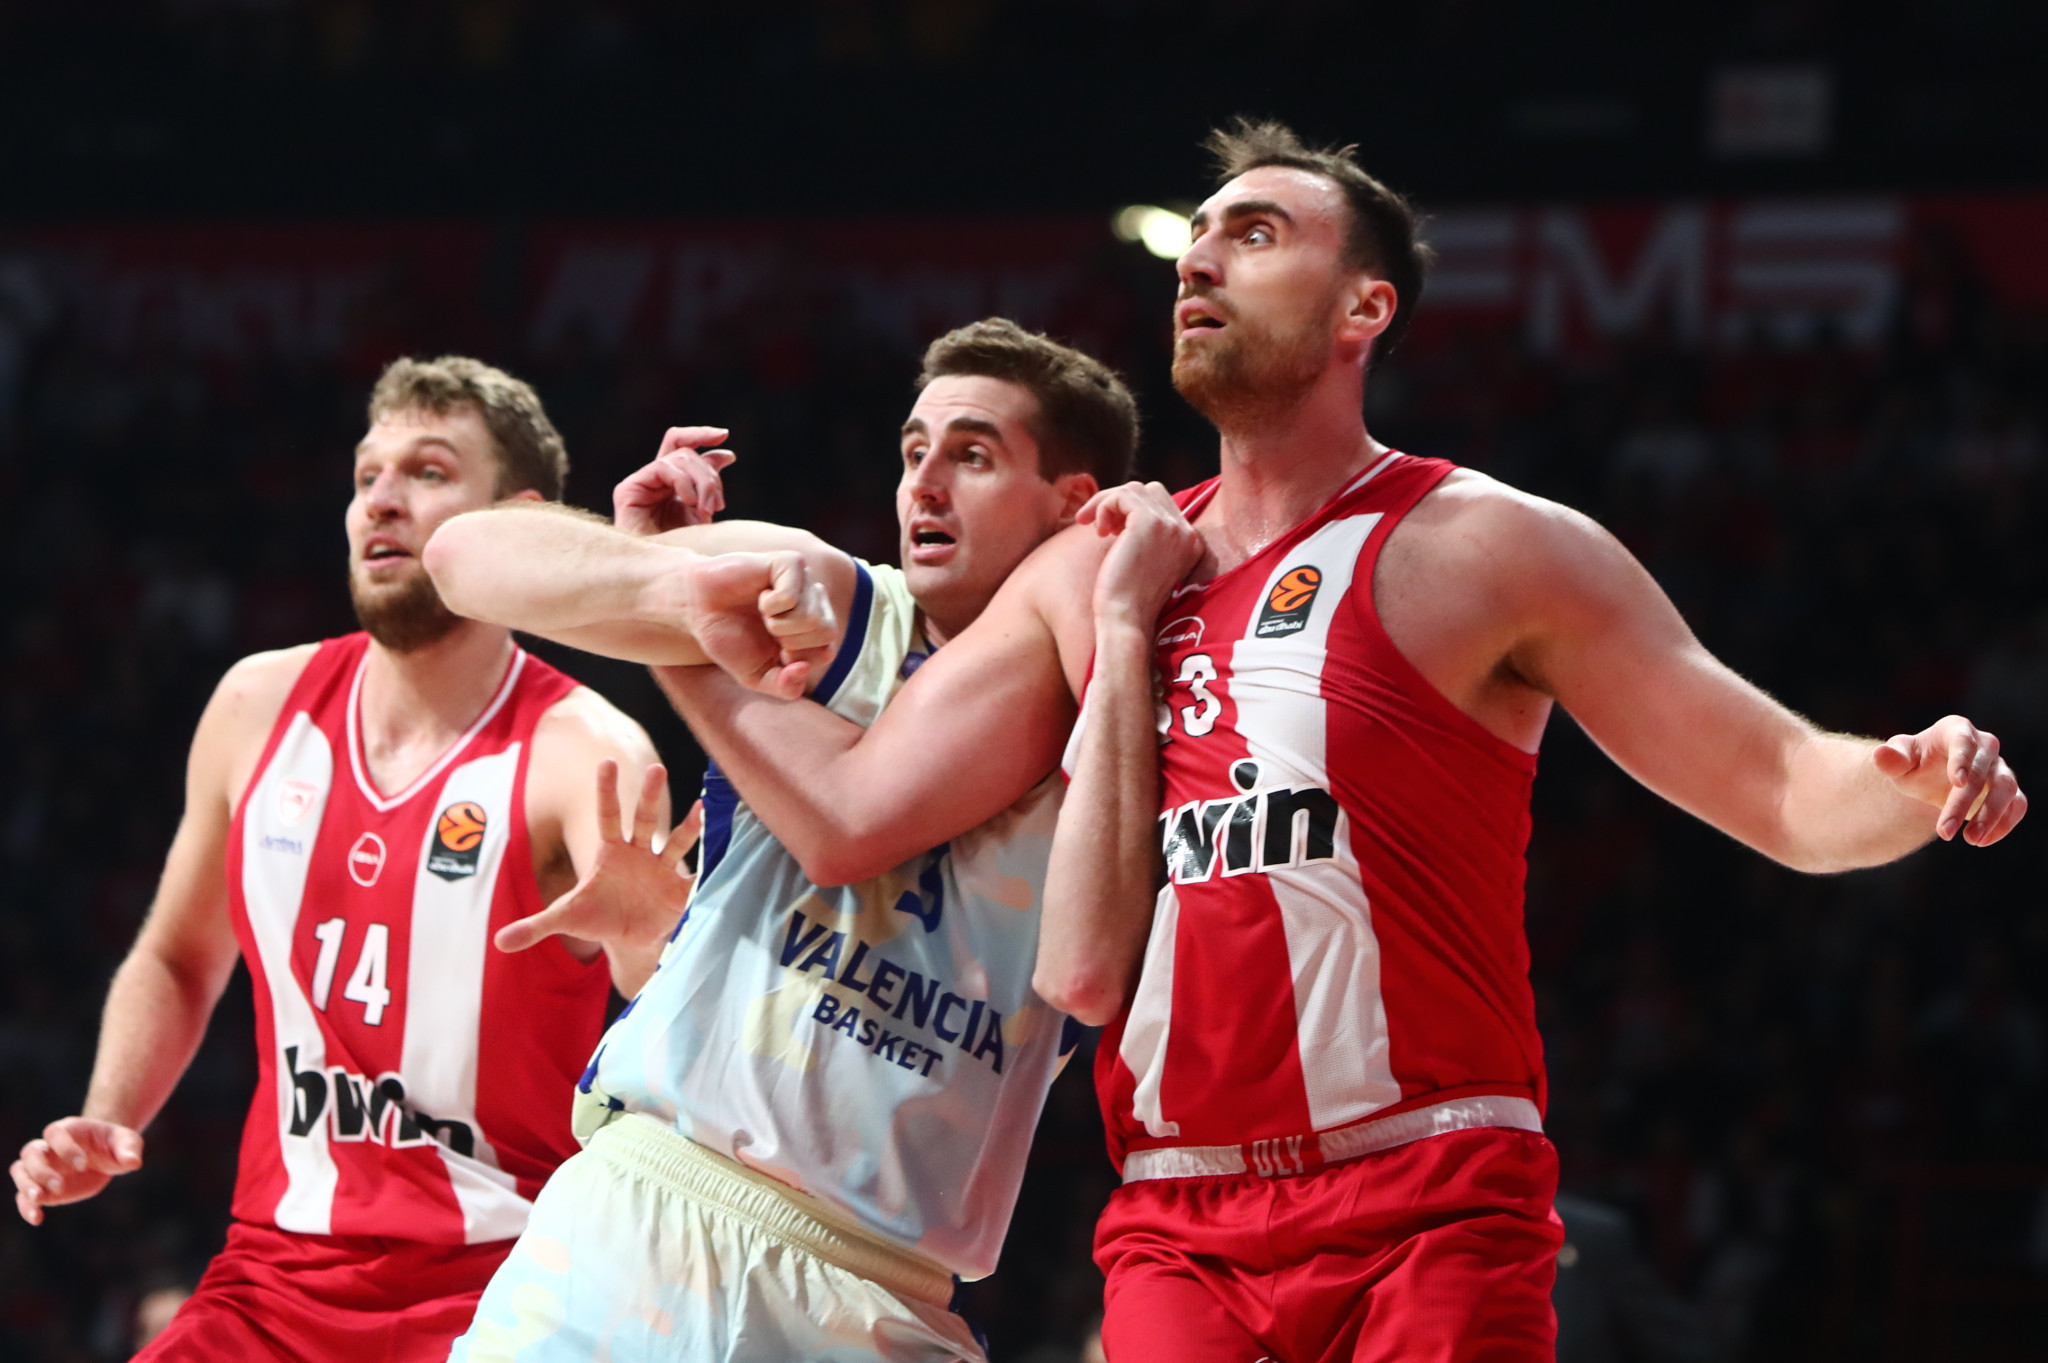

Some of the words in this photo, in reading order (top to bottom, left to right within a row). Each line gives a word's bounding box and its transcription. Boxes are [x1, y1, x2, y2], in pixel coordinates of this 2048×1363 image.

[1157, 652, 1222, 738] 3
[1158, 758, 1340, 884] win
[312, 916, 391, 1027] 14
[779, 910, 1005, 1076] VALENCIA
[812, 993, 943, 1078] BASKET
